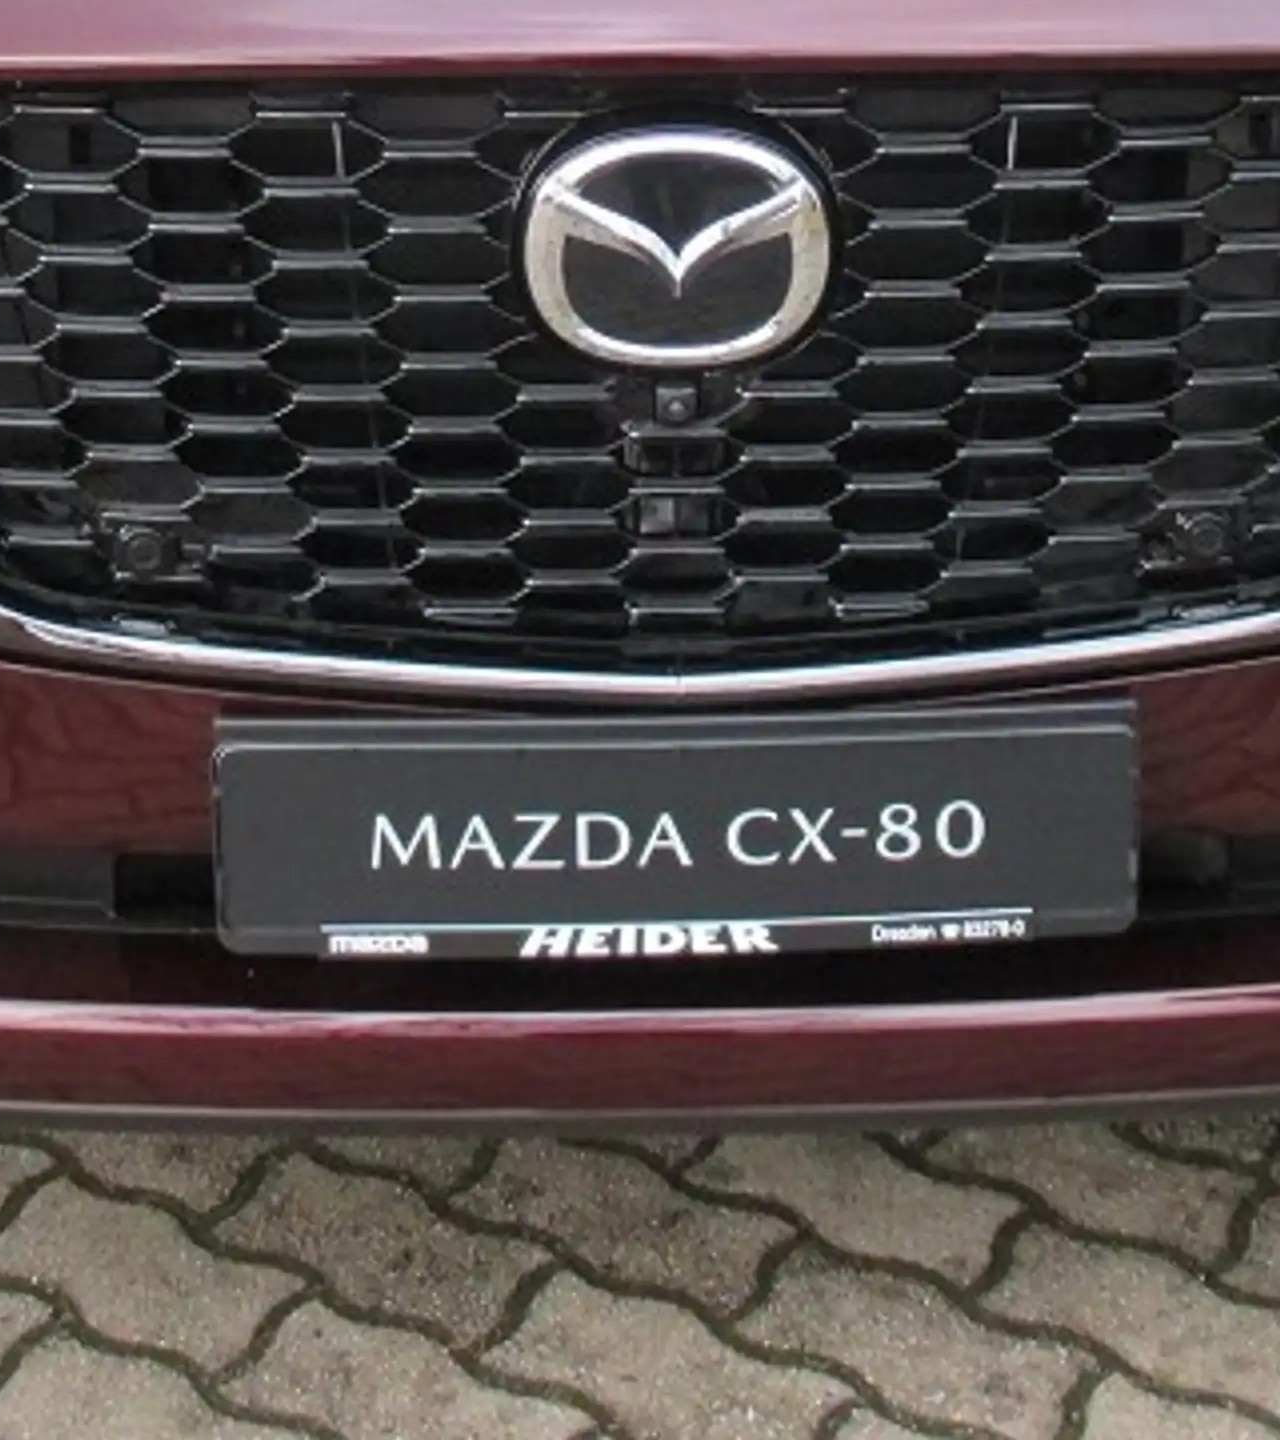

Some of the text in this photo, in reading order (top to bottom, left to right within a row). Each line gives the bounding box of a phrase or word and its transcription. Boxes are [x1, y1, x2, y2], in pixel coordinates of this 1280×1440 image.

[371, 800, 986, 870] MAZDA CX-80
[520, 924, 778, 957] HEIDER
